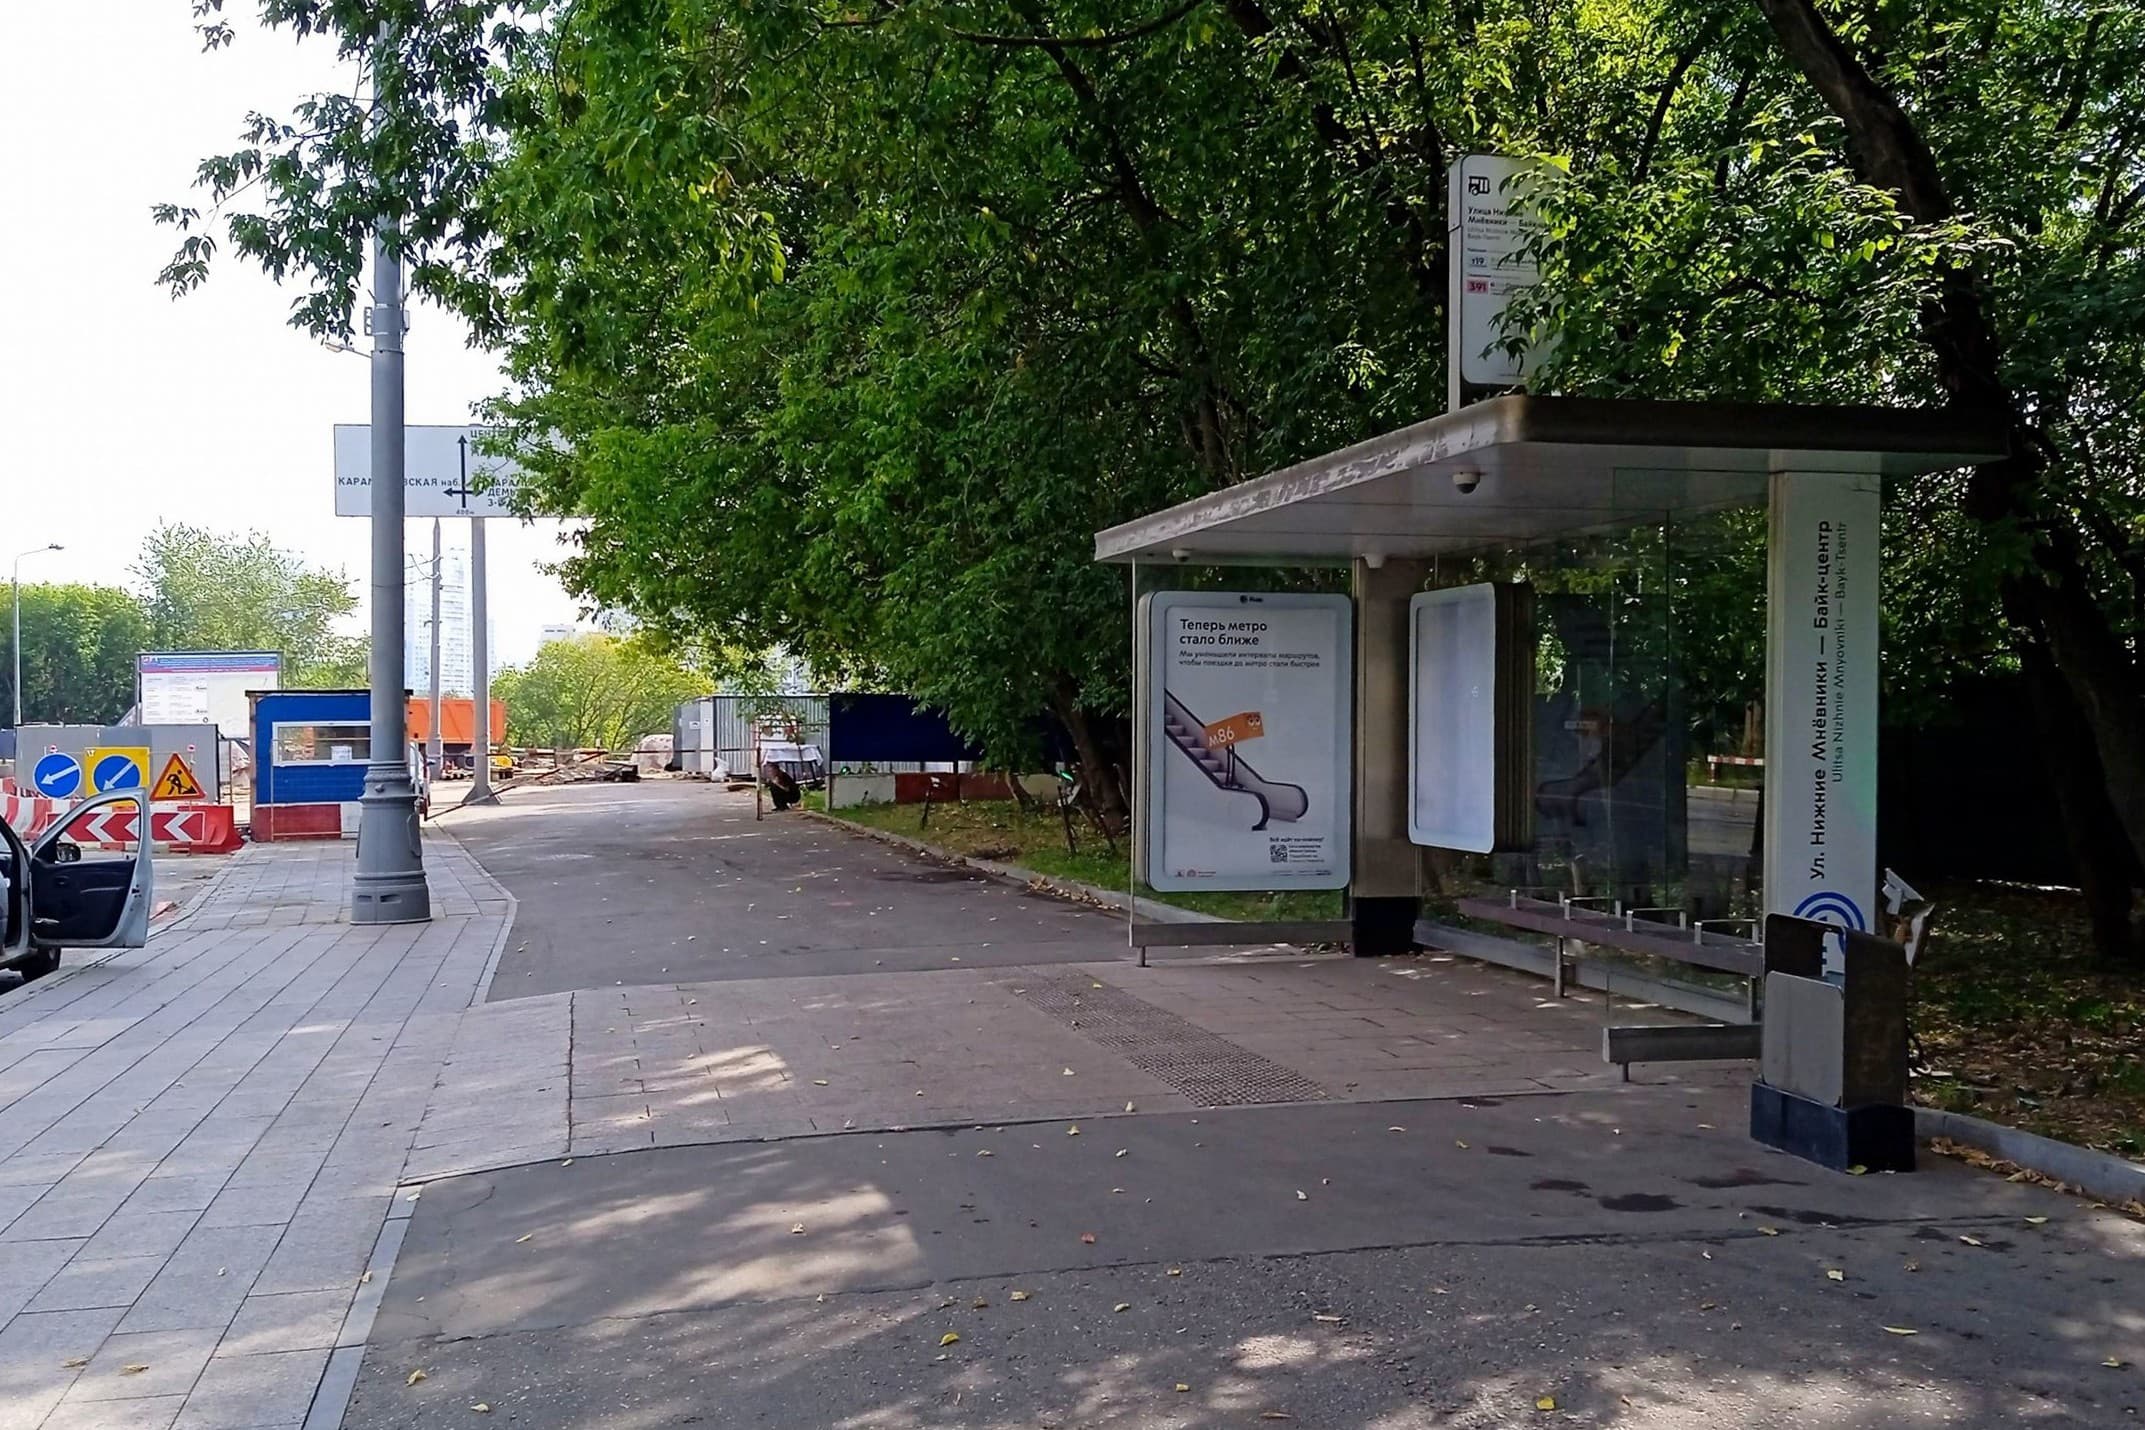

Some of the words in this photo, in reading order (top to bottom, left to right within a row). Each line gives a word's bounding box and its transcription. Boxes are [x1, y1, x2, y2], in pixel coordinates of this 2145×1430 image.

[338, 477, 438, 486] КАРАВСКАЯ
[1814, 520, 1832, 628] Байк-центр
[1835, 522, 1849, 599] Bayk-Tsentr
[1179, 635, 1215, 645] стало
[1219, 634, 1260, 645] ближе
[1180, 618, 1225, 633] Теперь
[1228, 621, 1268, 633] метро
[1833, 619, 1848, 689] Mnyovniki
[1812, 661, 1827, 761] Мнёвники
[1833, 692, 1845, 743] Nizhnie
[1832, 746, 1844, 783] Ulitsa
[1810, 769, 1826, 845] Нижние
[1810, 851, 1825, 880] Ул.
